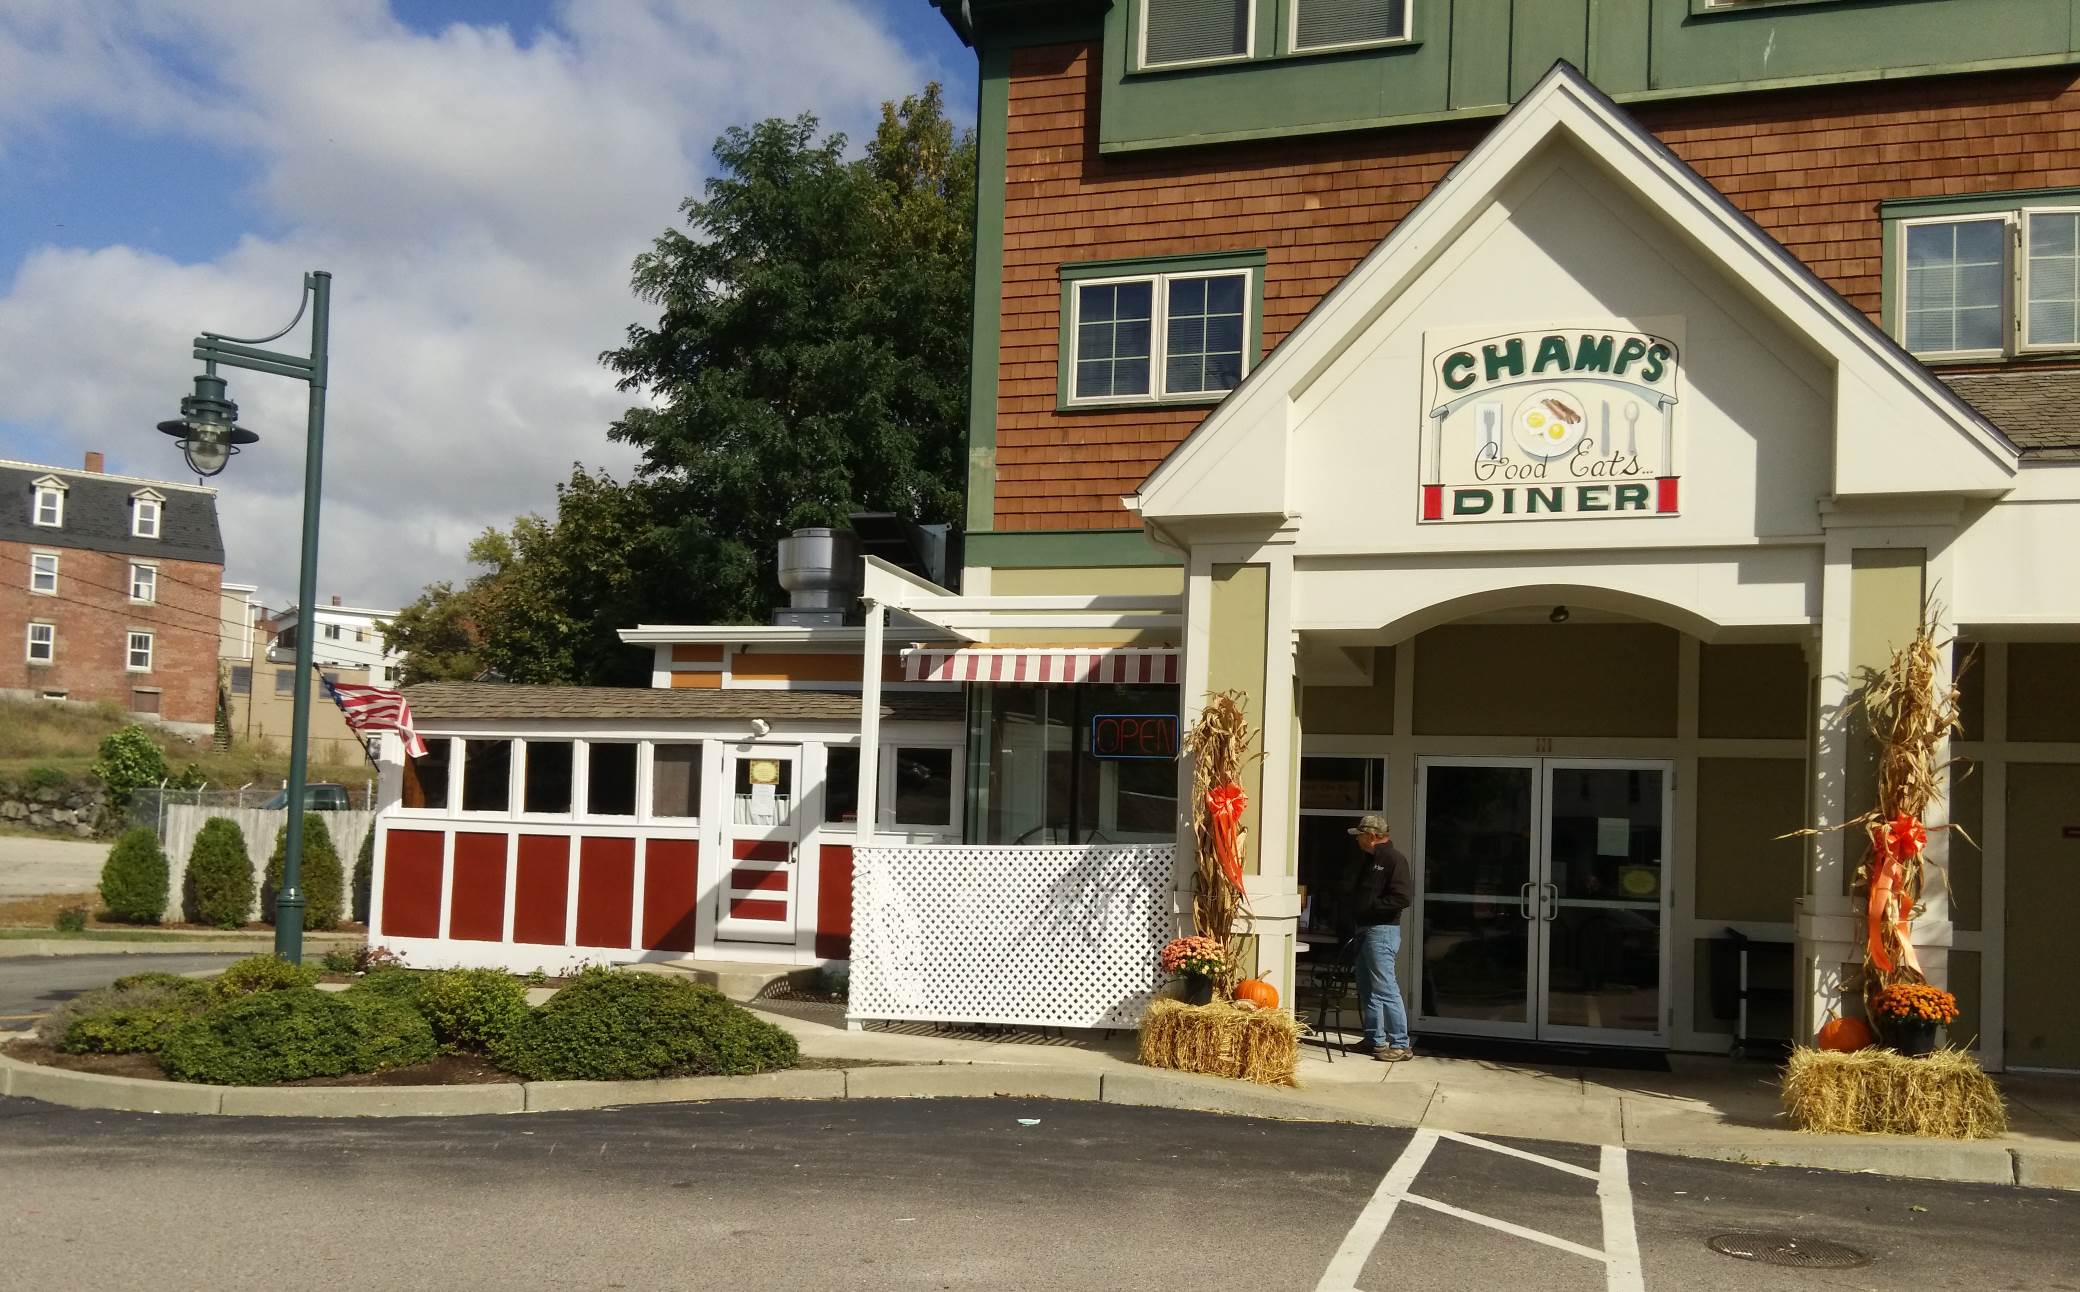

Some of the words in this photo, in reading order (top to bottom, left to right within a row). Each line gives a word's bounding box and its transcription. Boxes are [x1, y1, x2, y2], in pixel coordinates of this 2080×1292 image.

[1442, 335, 1670, 390] CHAMP'S
[1474, 441, 1549, 481] Good
[1453, 483, 1650, 515] DINER
[1097, 719, 1175, 755] OPEN
